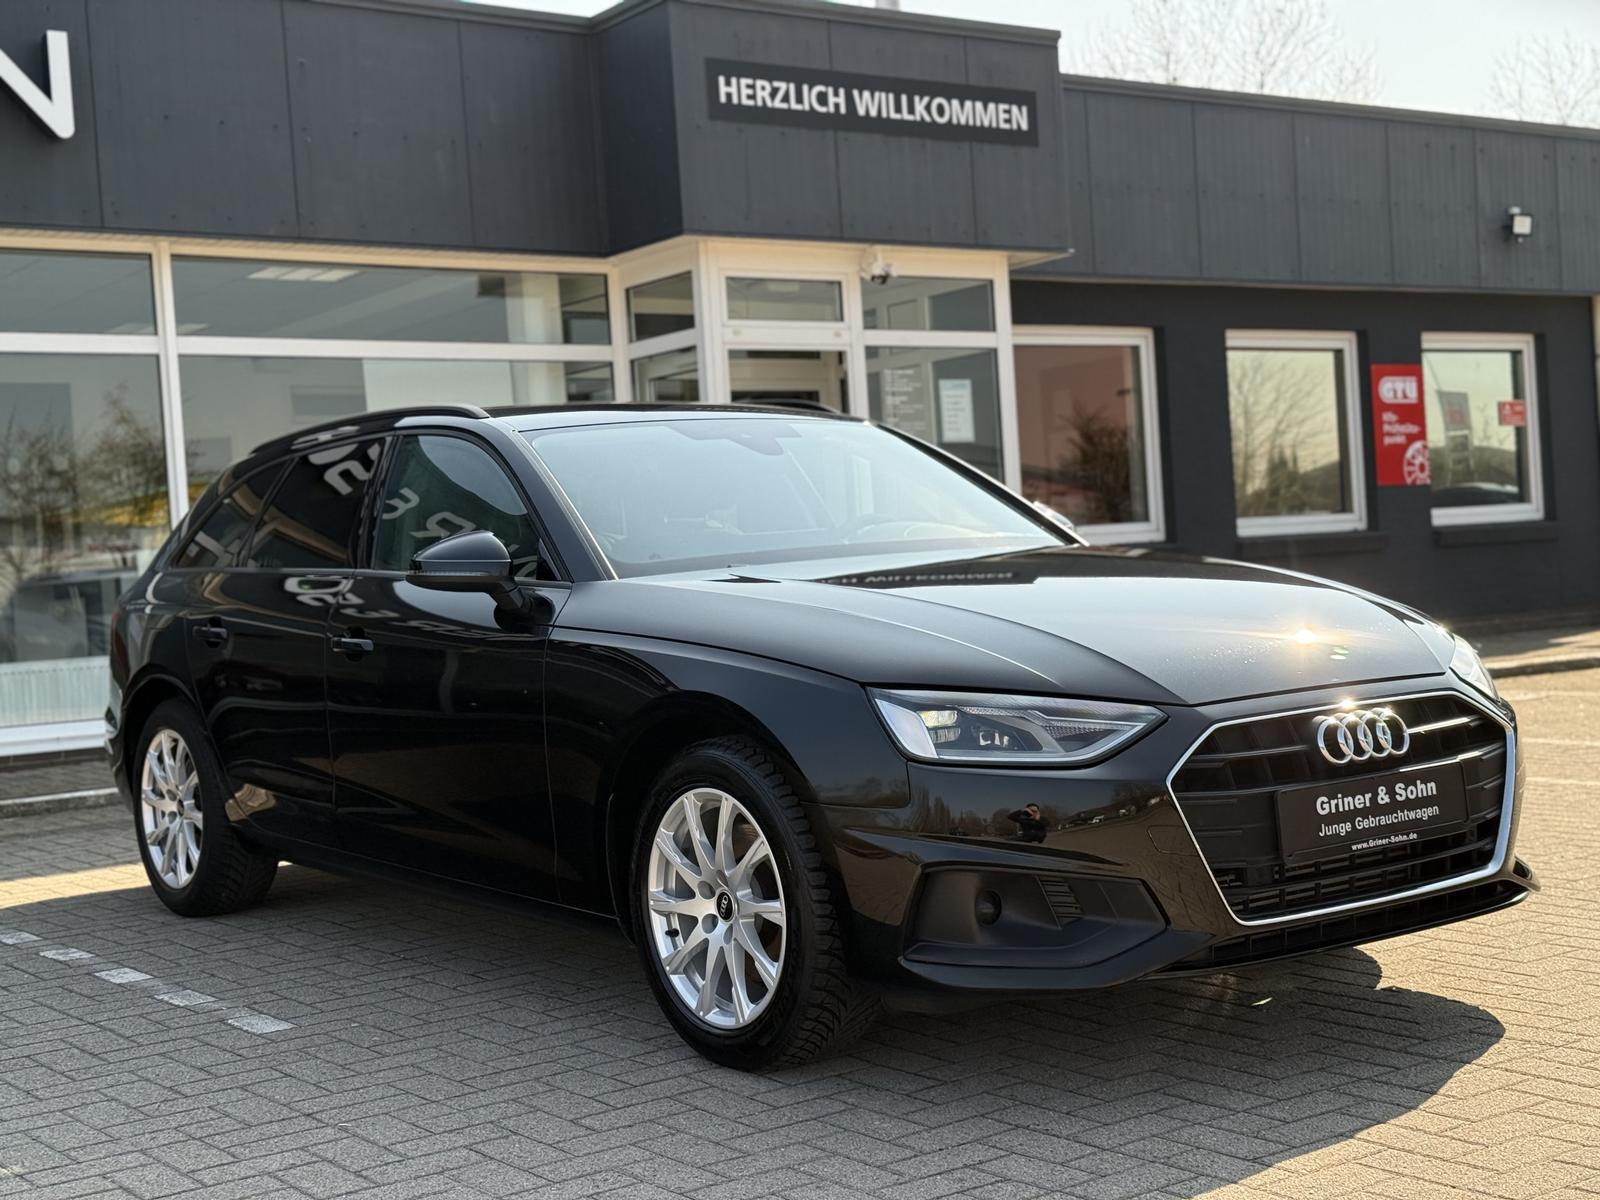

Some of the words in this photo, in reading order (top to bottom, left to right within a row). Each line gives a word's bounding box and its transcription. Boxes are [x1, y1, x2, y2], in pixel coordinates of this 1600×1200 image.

[718, 75, 846, 114] HERZLICH
[852, 88, 1029, 131] WILLKOMMEN
[1316, 791, 1372, 815] Griner
[1377, 786, 1390, 804] &
[1394, 780, 1437, 801] Sohn
[1318, 822, 1352, 837] Junge
[1355, 805, 1440, 830] Gebrauchtwagen
[1351, 832, 1418, 851] www.Griner-Sohn.de
